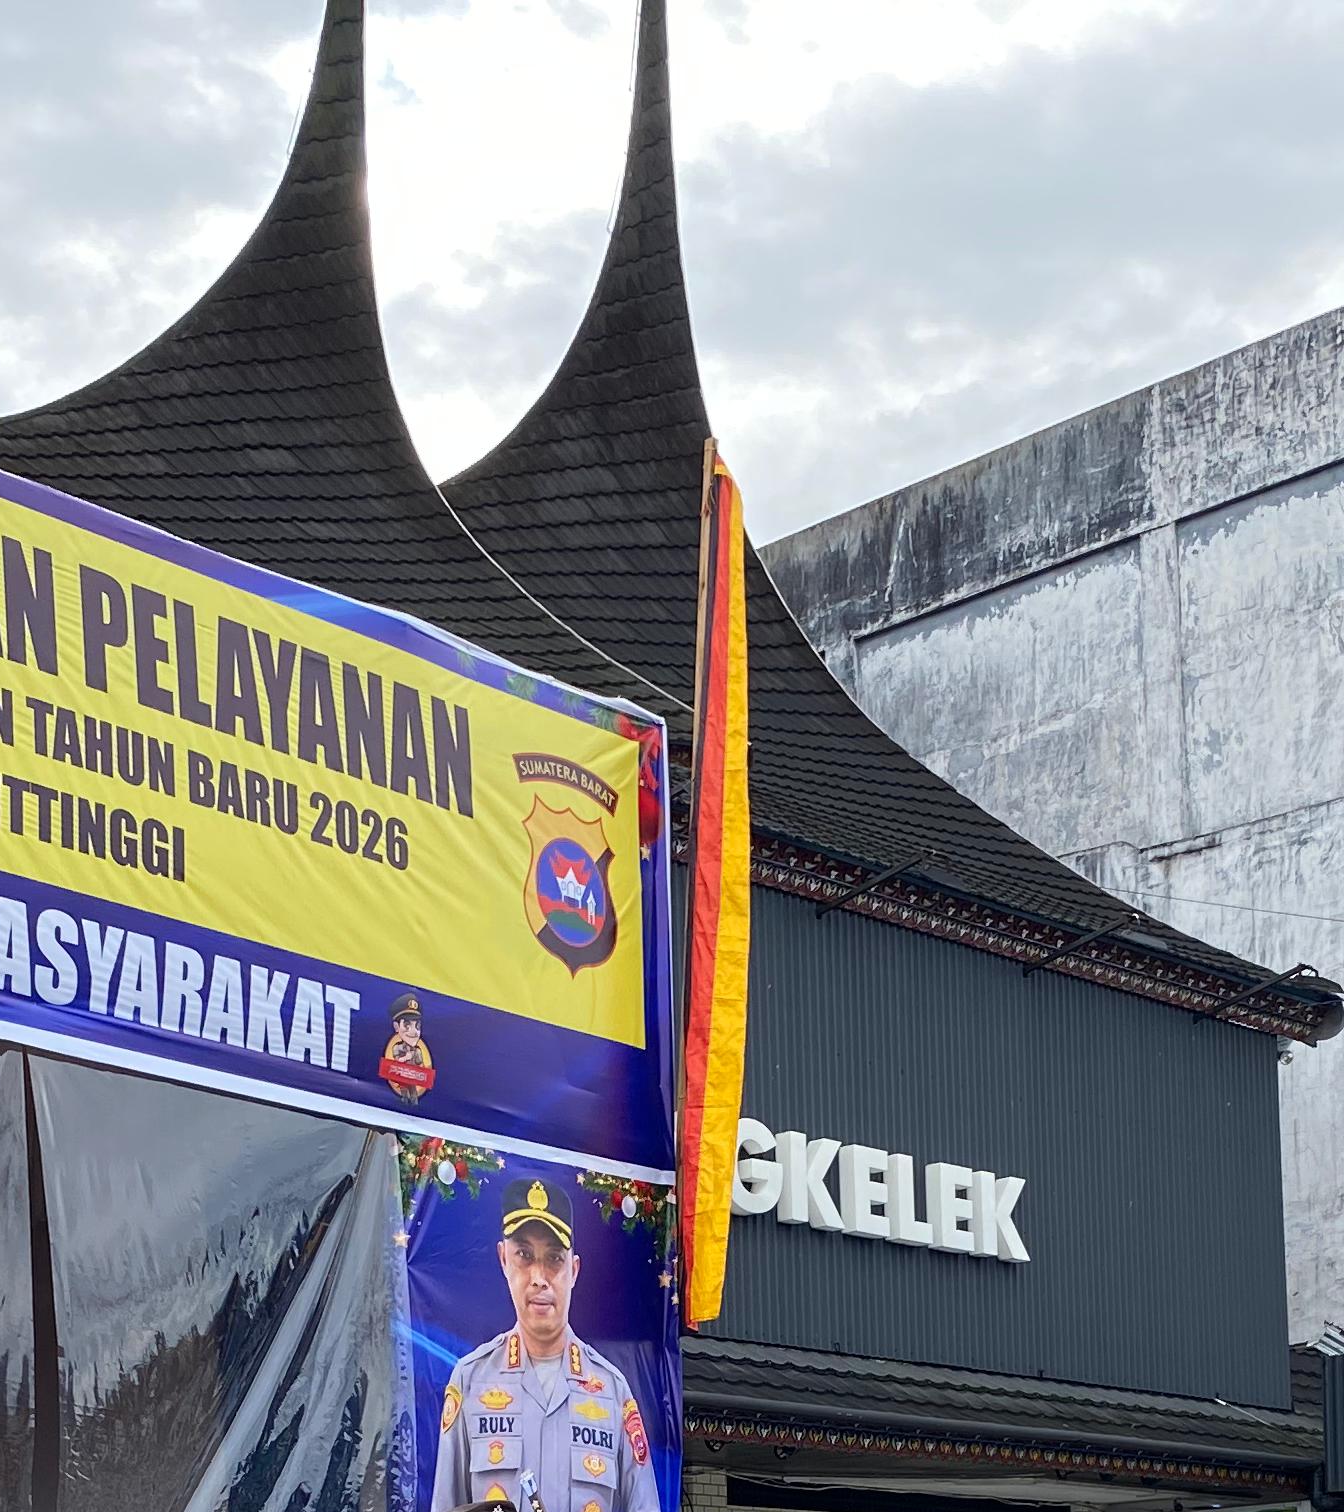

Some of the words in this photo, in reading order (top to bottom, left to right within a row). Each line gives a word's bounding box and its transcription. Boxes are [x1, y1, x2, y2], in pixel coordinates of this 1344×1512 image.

[79, 562, 474, 818] PELAYANAN
[27, 693, 175, 799] TAHUN
[187, 755, 298, 832] BARU
[309, 792, 410, 872] 2026
[519, 759, 579, 784] SUMATERA
[581, 773, 616, 808] BARAT
[730, 1117, 1031, 1263] GKELEK
[479, 1416, 516, 1434] RULY
[571, 1425, 614, 1450] POLRI
